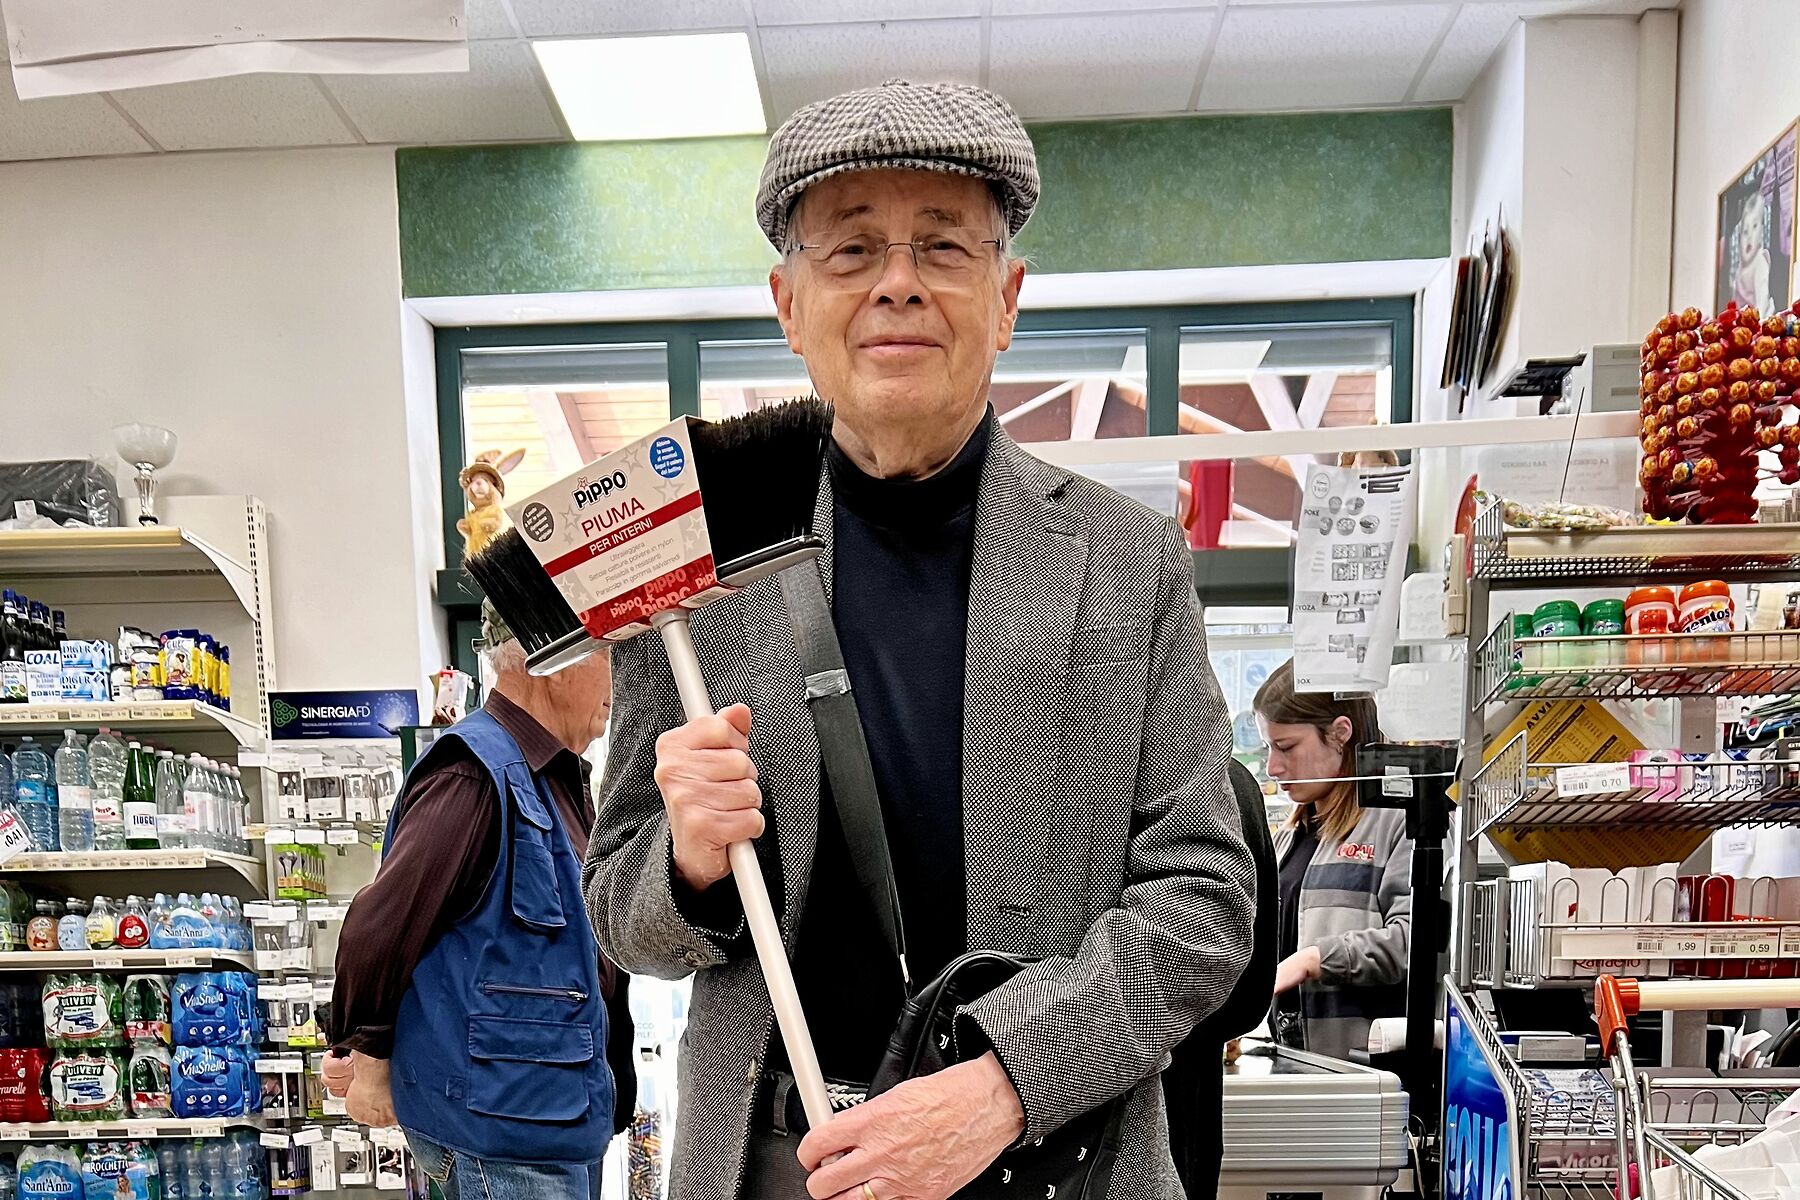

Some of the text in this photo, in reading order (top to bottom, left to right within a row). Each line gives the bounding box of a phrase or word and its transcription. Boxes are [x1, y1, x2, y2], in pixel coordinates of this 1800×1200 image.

[581, 497, 645, 537] PIUMA
[589, 518, 653, 555] PER INTERNI
[609, 542, 646, 561] Ultraleggera
[26, 653, 60, 665] COAL
[301, 706, 371, 719] SINERGIAFD
[1337, 843, 1376, 861] COAL
[67, 1064, 101, 1076] ULIVETO
[24, 1177, 73, 1193] Sant'Anna
